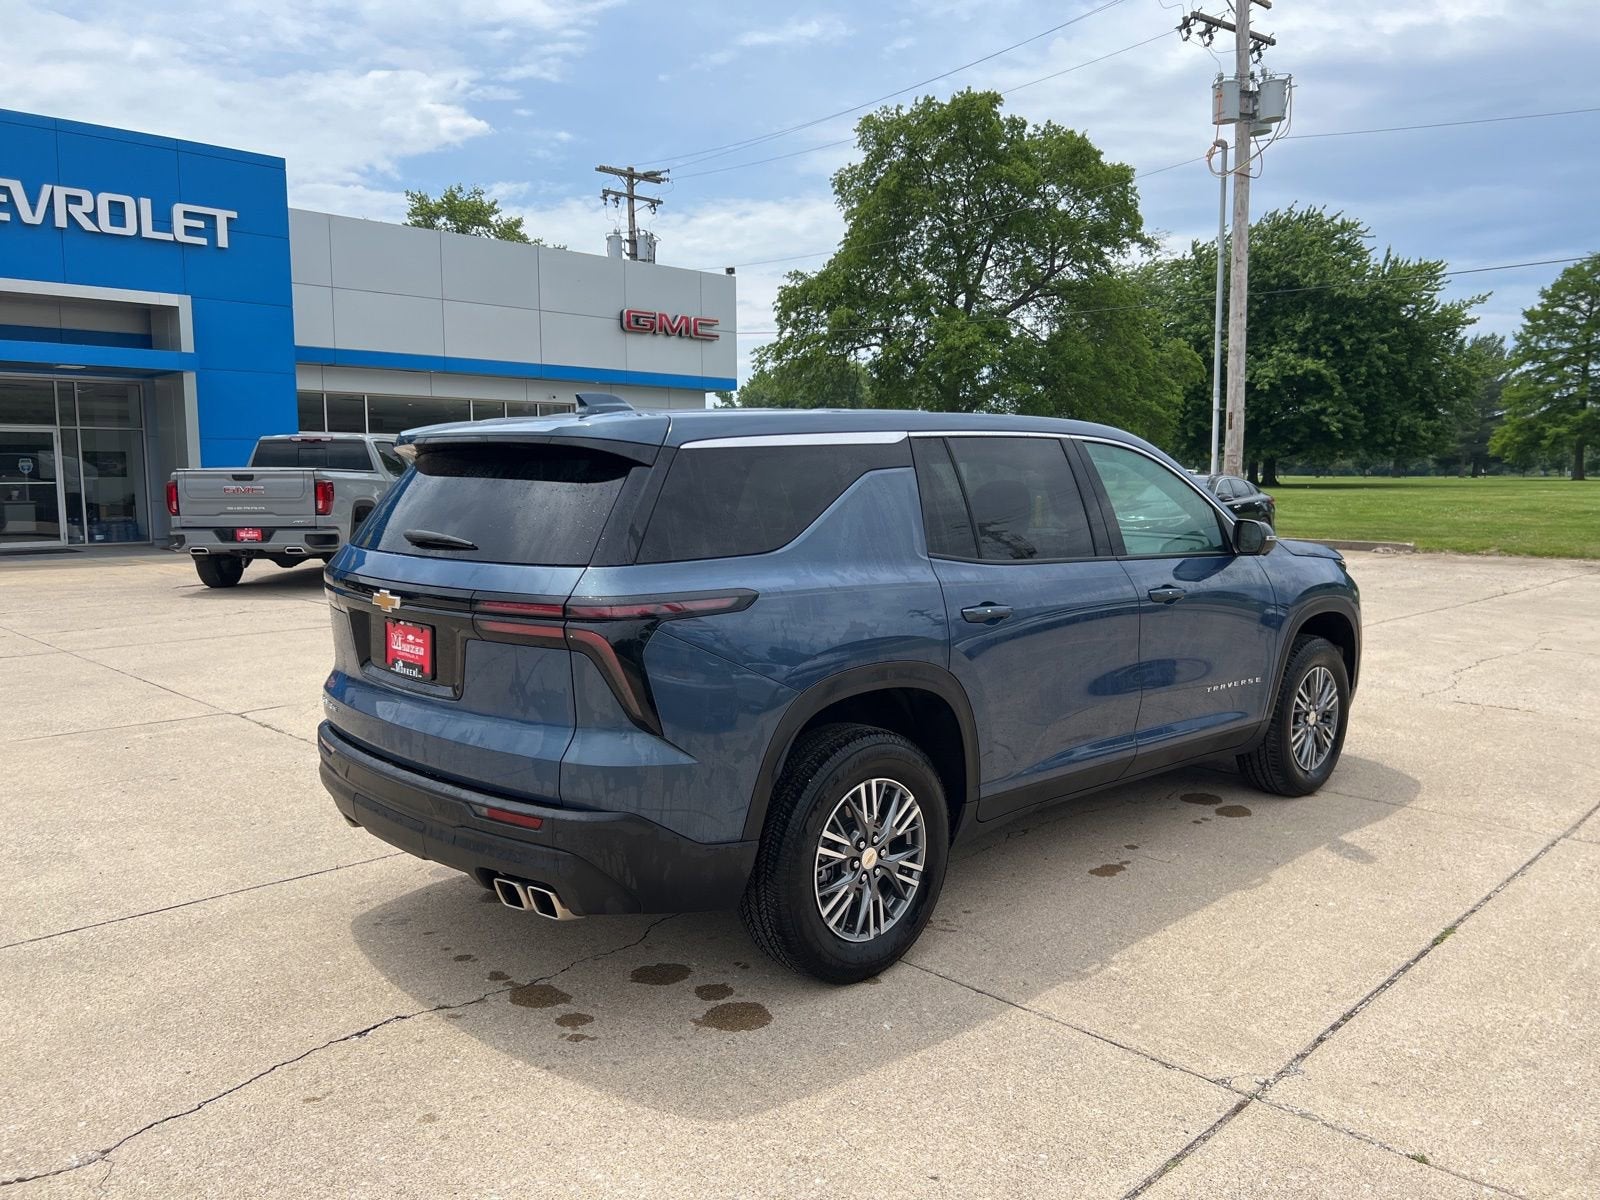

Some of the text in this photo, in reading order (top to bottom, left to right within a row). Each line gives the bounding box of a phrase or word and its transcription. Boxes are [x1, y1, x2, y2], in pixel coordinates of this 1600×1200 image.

[620, 308, 720, 341] GMC
[223, 485, 265, 495] GMC
[1206, 677, 1263, 693] TRAVERSE
